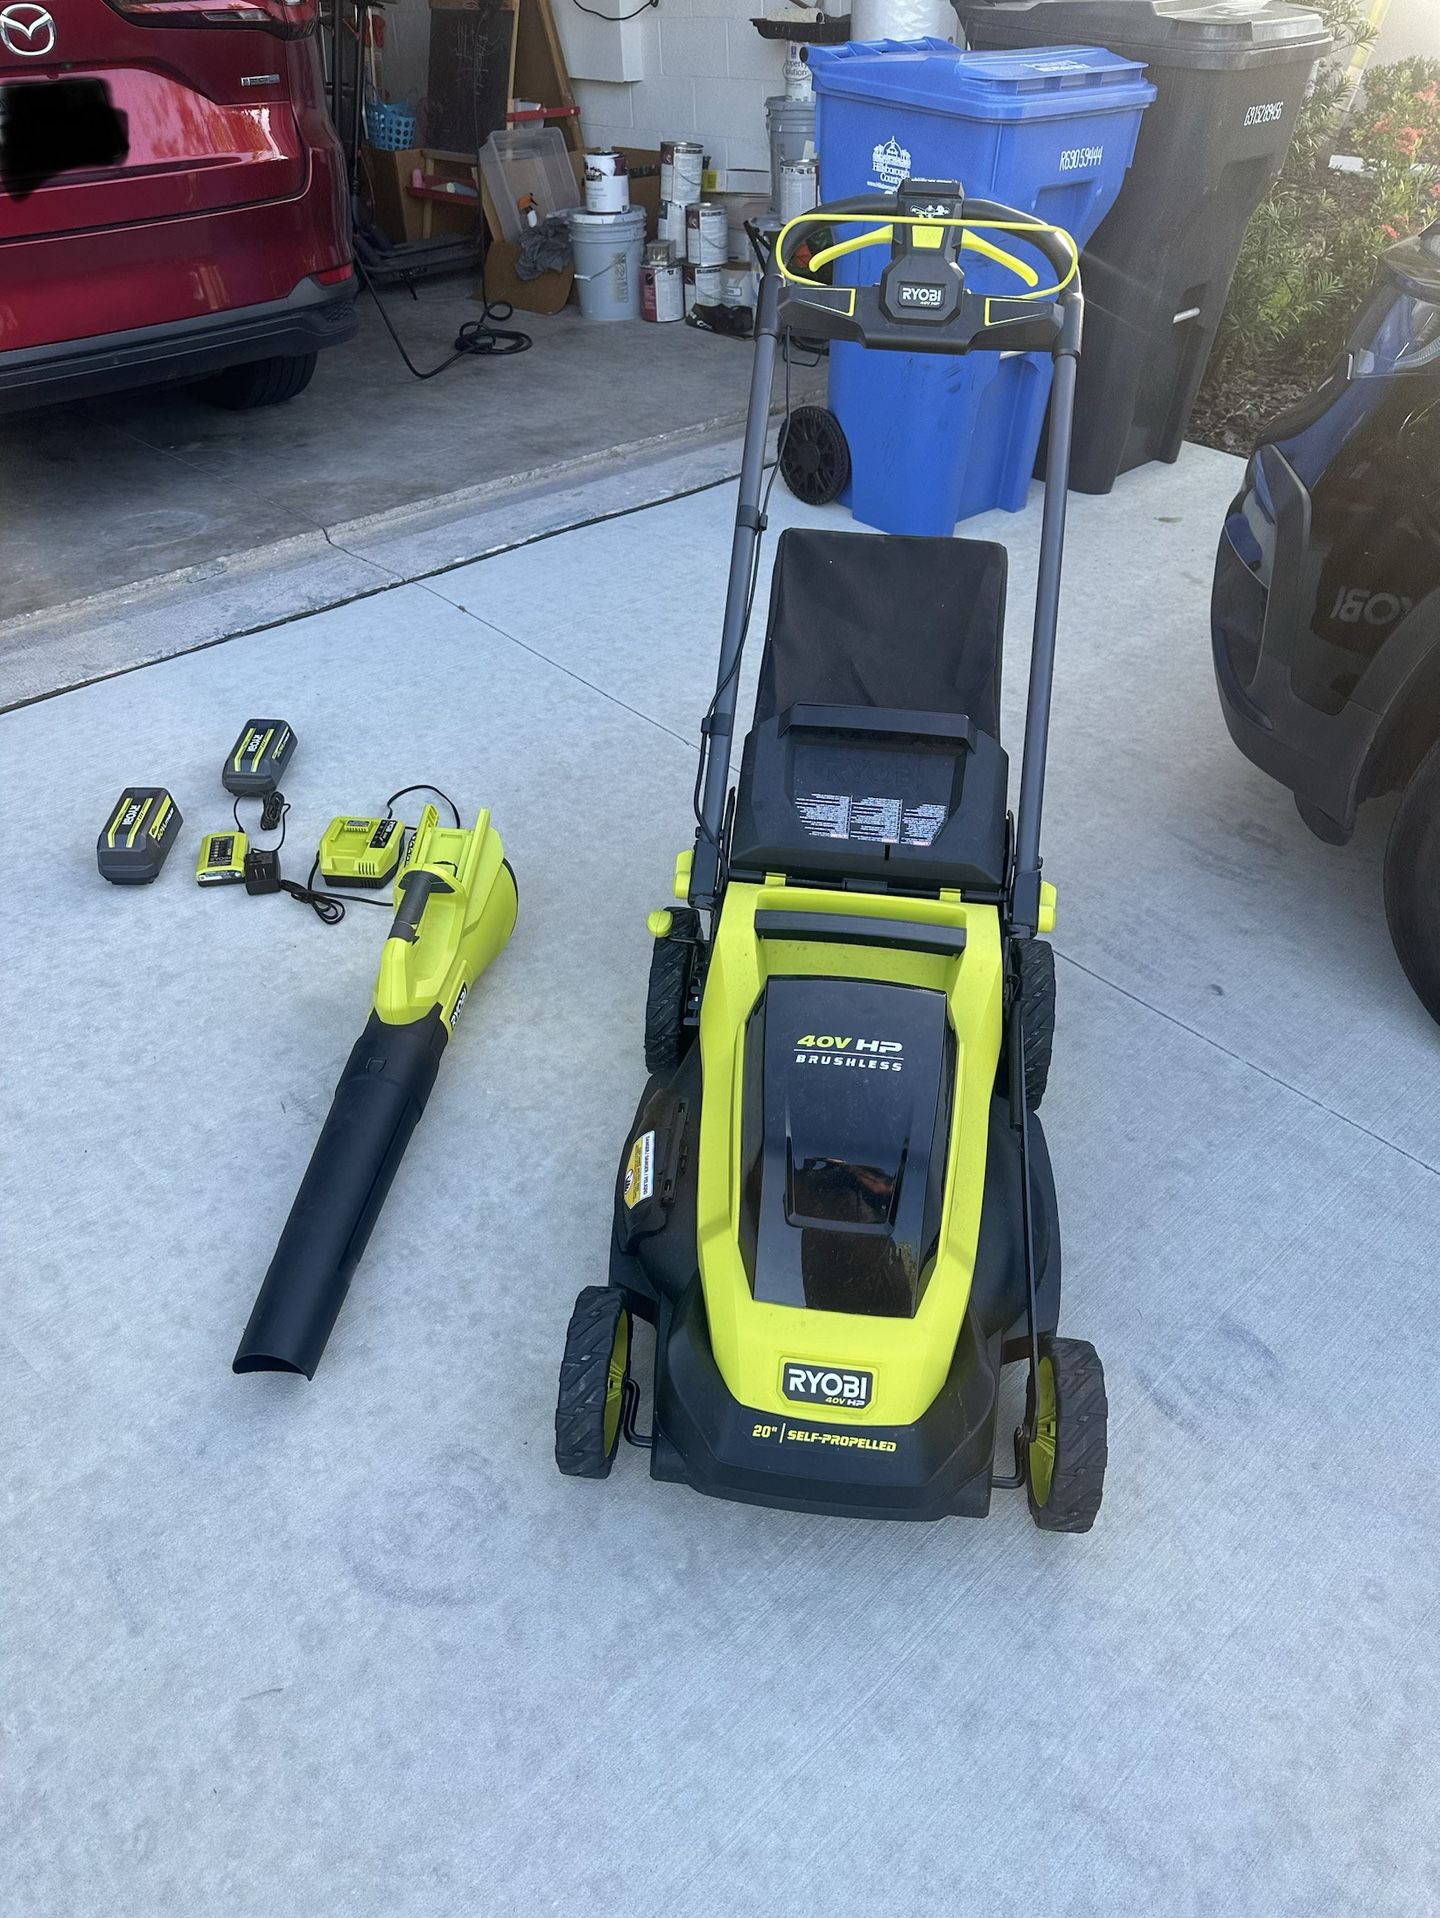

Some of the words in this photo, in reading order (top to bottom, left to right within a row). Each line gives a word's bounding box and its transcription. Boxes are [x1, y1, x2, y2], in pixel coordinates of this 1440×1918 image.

[902, 287, 942, 302] RYOBI
[247, 734, 264, 752] RYOBI
[121, 804, 141, 825] RYOBI
[450, 987, 466, 1026] RYOBI
[797, 1034, 852, 1049] 40V
[855, 1038, 903, 1053] HP
[795, 1054, 903, 1072] BRUSHLESS
[788, 1368, 868, 1399] RYOBI
[825, 1396, 846, 1405] 40V
[846, 1399, 866, 1407] HP
[752, 1424, 778, 1438] 20"
[787, 1429, 897, 1453] SELF-PROPELLED
